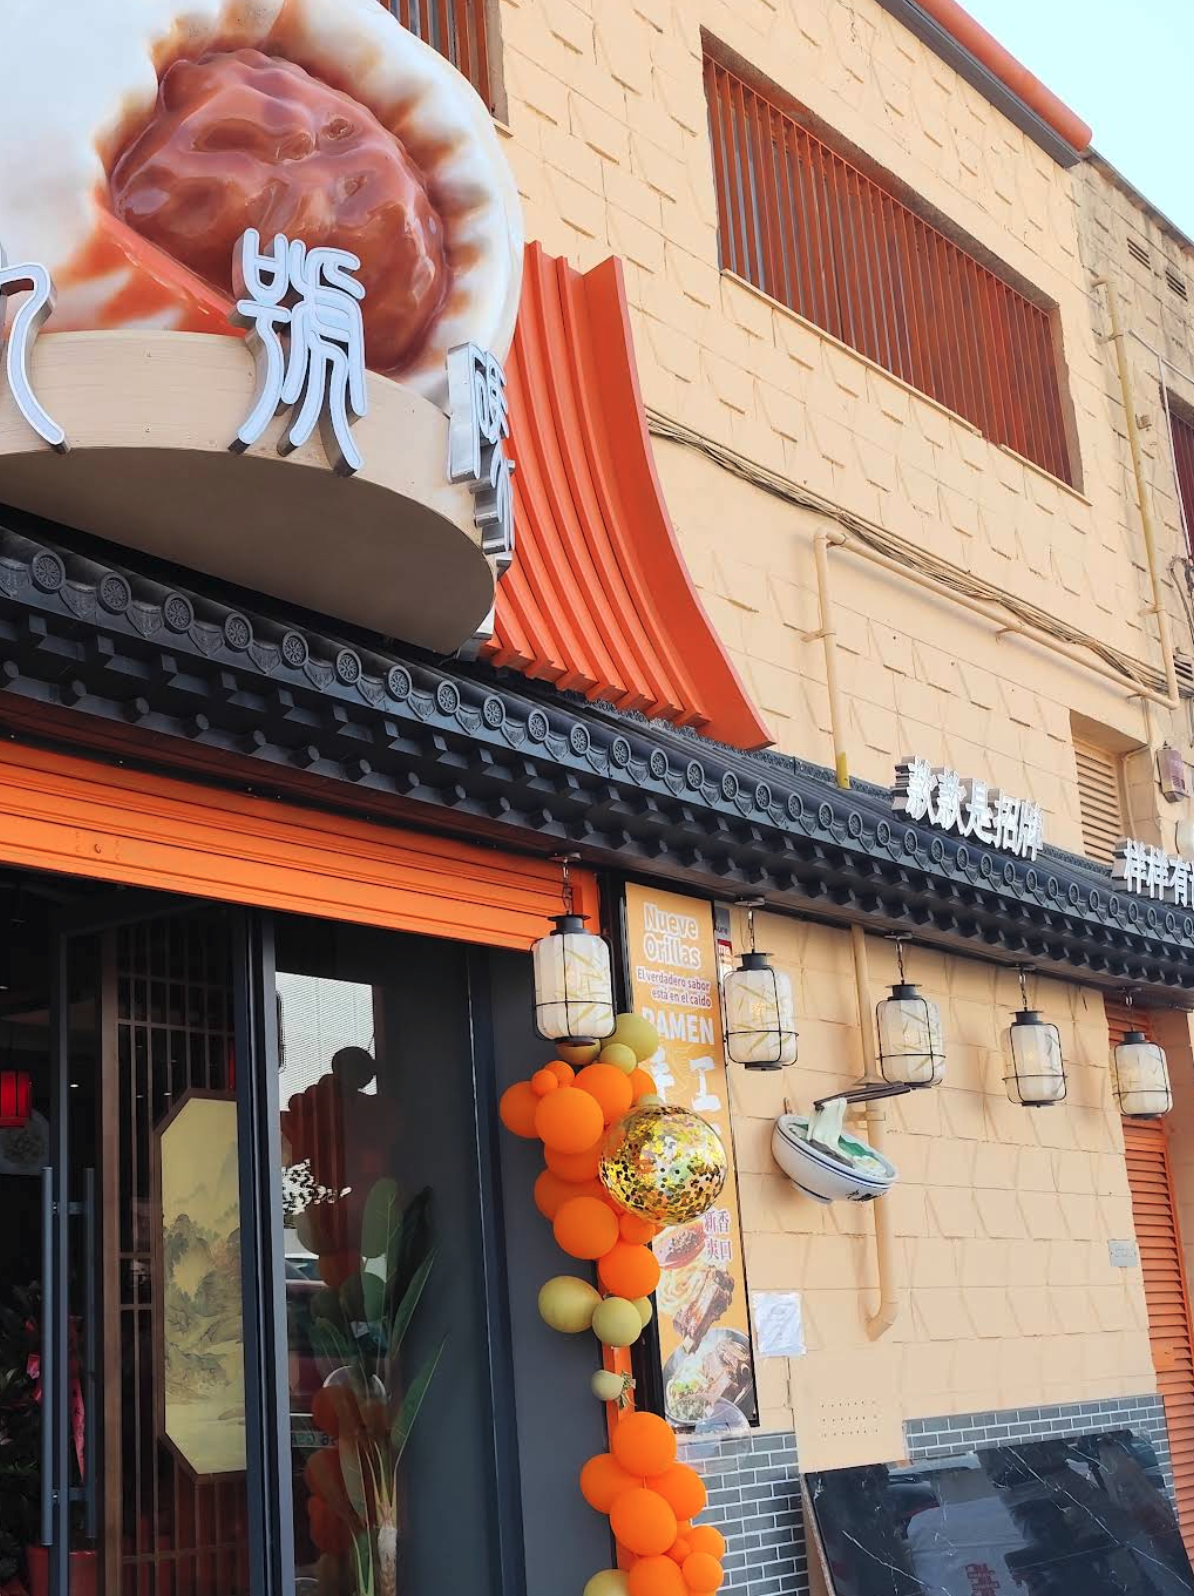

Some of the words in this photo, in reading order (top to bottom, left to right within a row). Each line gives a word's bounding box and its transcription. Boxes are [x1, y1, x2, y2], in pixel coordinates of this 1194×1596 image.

[1123, 837, 1194, 911] 样样有
[644, 903, 698, 938] Nueve
[644, 934, 700, 968] Orillas
[637, 968, 646, 980] El
[647, 970, 686, 987] verdadero
[687, 977, 710, 991] sabor
[670, 991, 680, 1001] en
[681, 992, 689, 1003] el
[690, 995, 711, 1007] caldo
